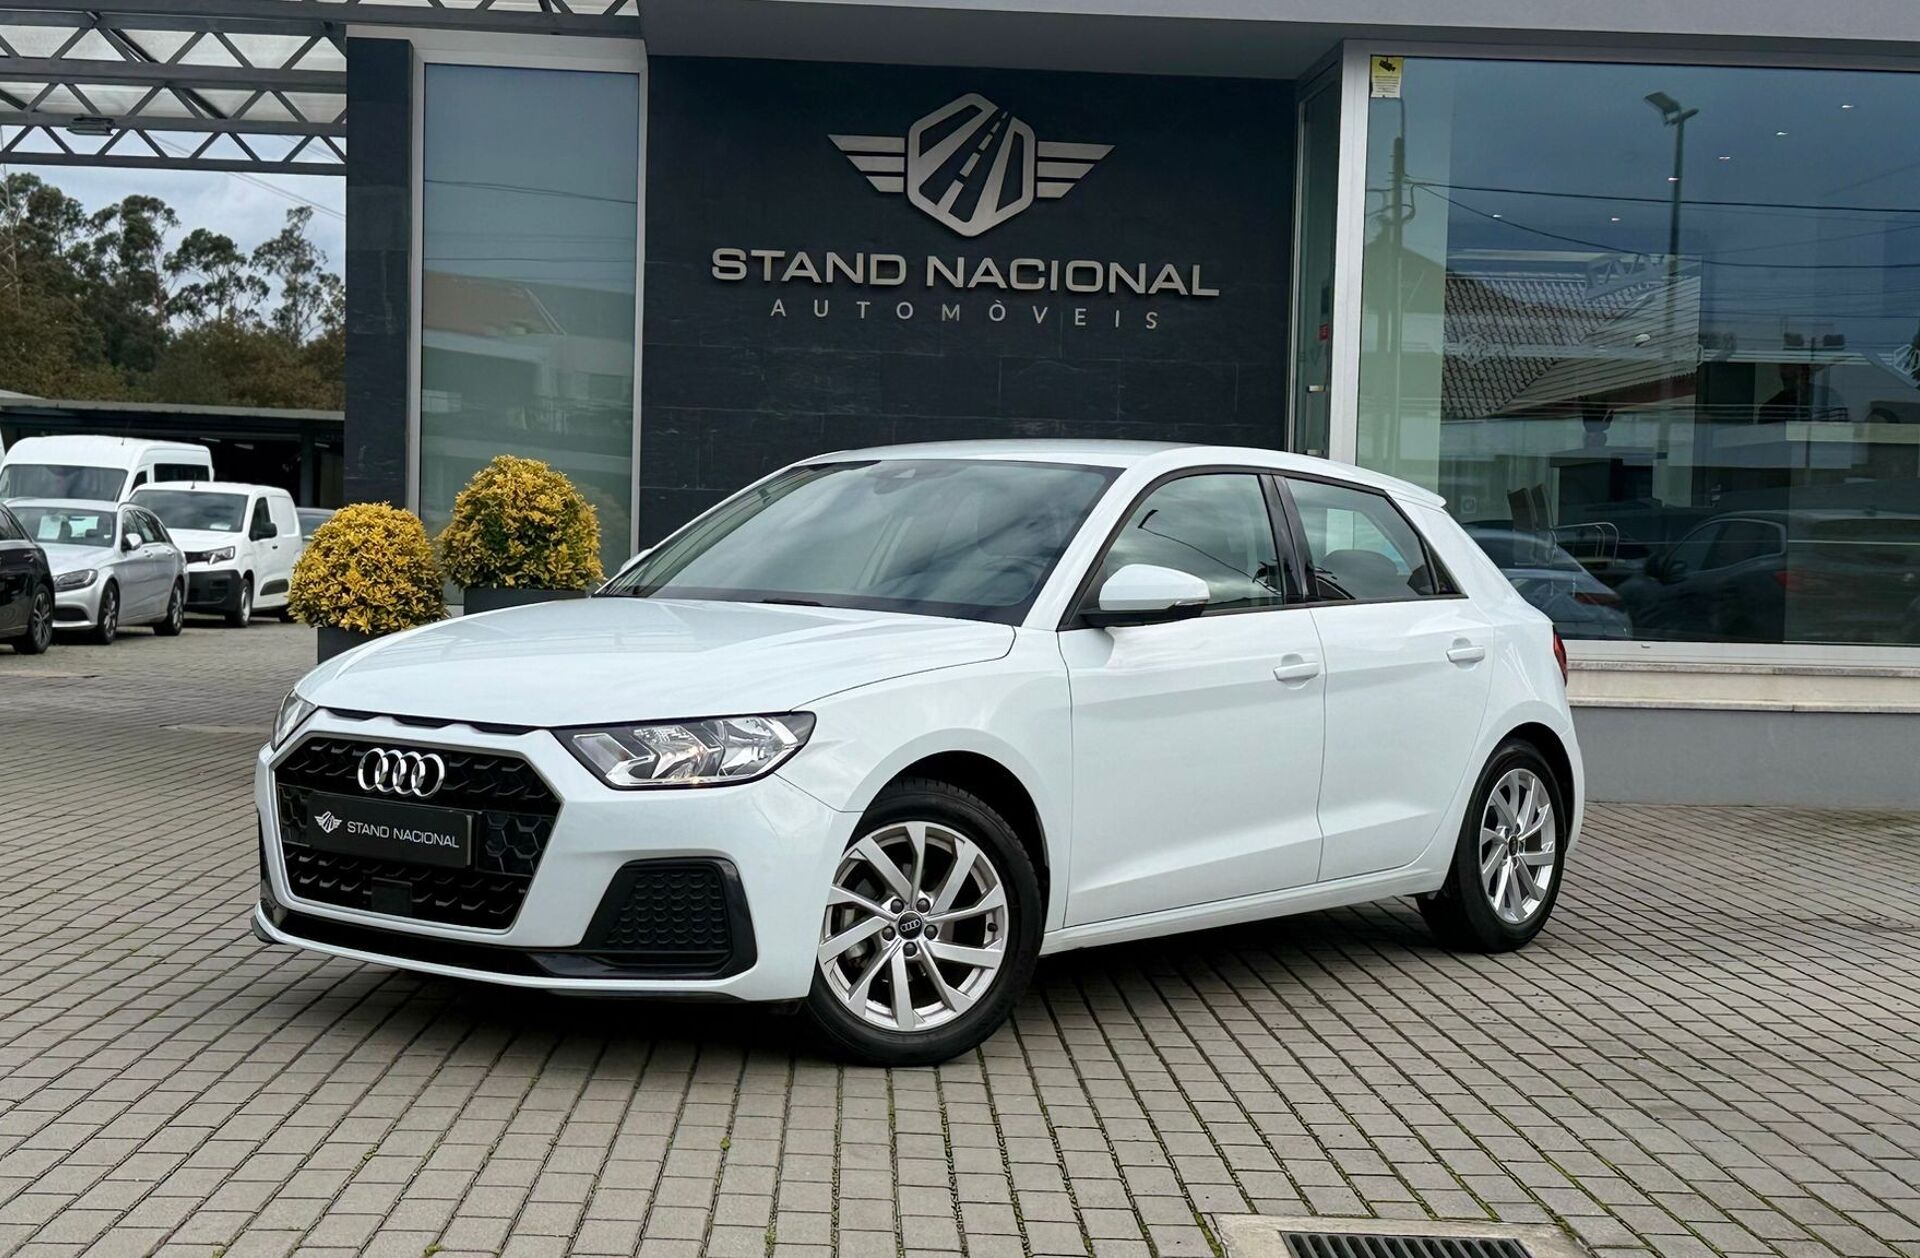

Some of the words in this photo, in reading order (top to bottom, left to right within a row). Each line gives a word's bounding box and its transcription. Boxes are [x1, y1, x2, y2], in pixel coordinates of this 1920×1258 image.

[711, 248, 906, 285] STAND
[926, 256, 1220, 297] NACIONAL
[347, 820, 390, 839] STAND
[393, 827, 460, 848] NACIONAL
